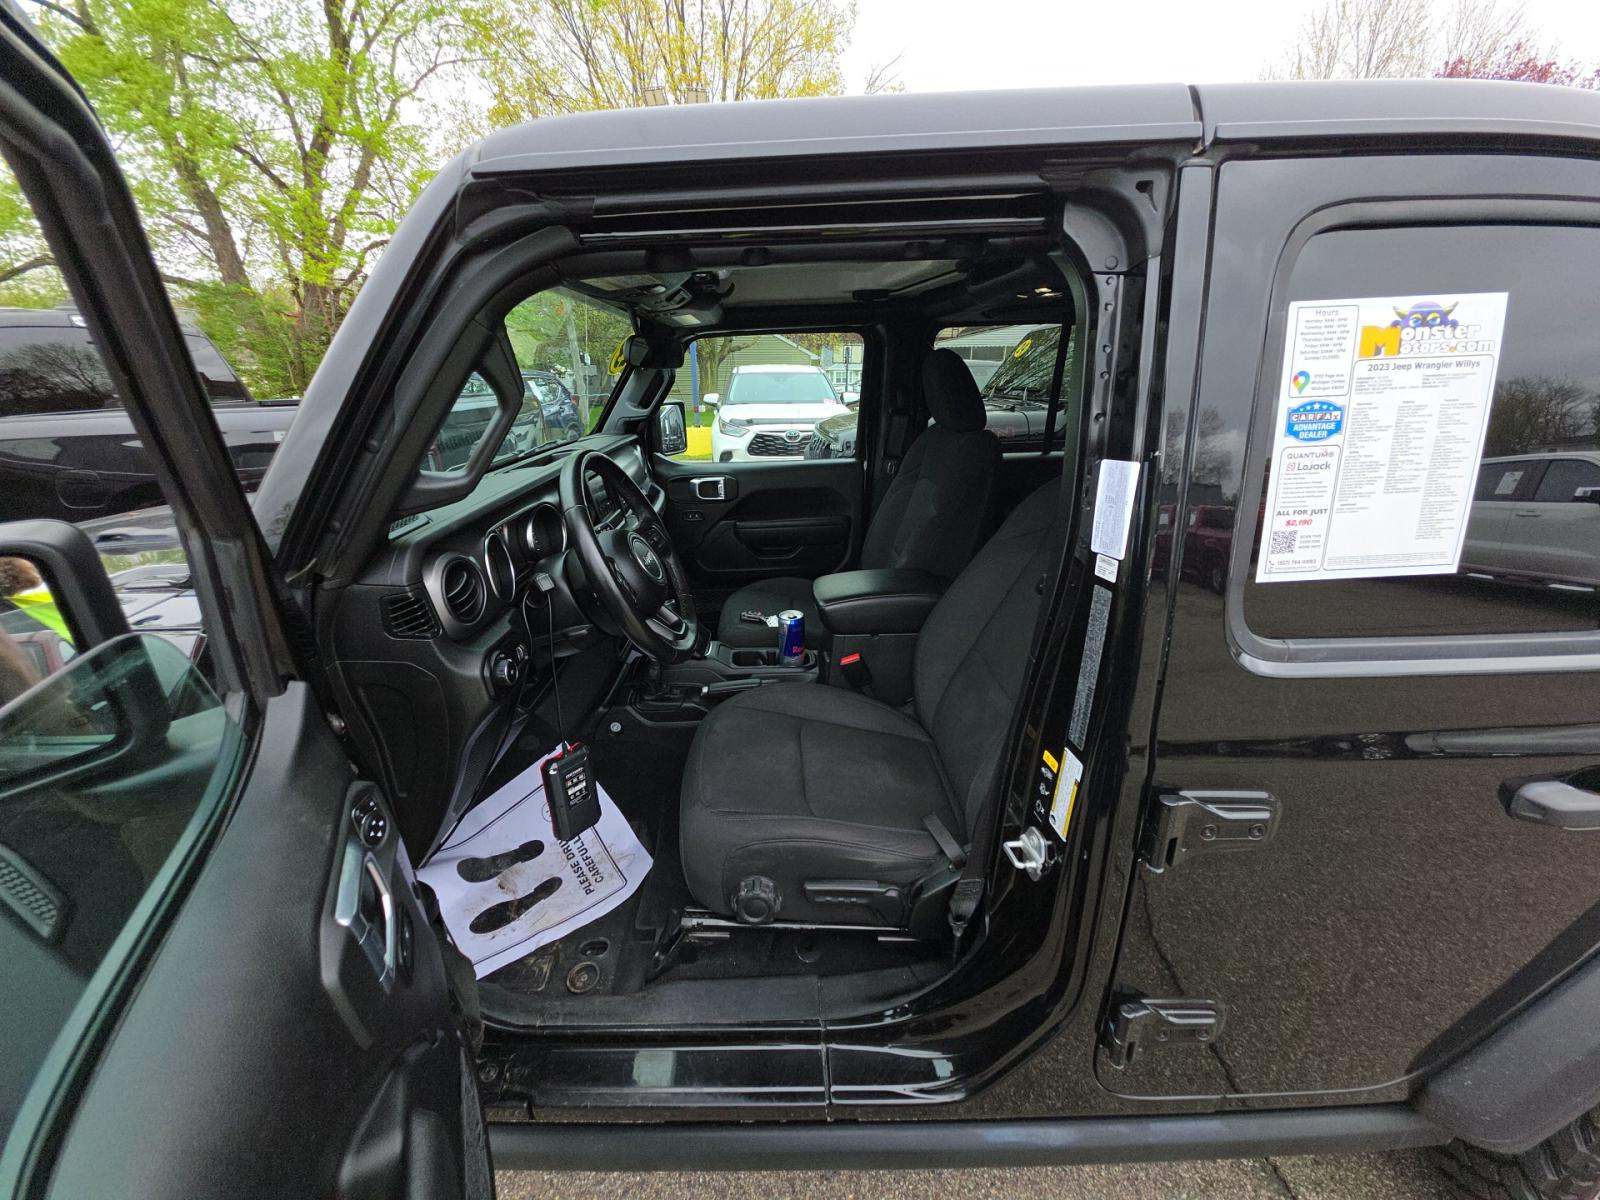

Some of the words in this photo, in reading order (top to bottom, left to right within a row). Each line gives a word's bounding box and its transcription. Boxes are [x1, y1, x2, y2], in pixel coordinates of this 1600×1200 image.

[1315, 309, 1340, 317] Hours
[1367, 363, 1390, 372] 2023
[1391, 362, 1412, 372] Jeep
[1414, 361, 1453, 371] Wrangler
[1455, 360, 1481, 369] Willys
[1291, 412, 1341, 422] CARFAX
[1292, 422, 1337, 432] ADVANTAGE
[1298, 431, 1328, 439] DEALER
[1310, 508, 1329, 516] JUST
[558, 839, 576, 861] DRIV
[573, 834, 604, 883] CAREFULL
[569, 860, 595, 895] PLEASE
